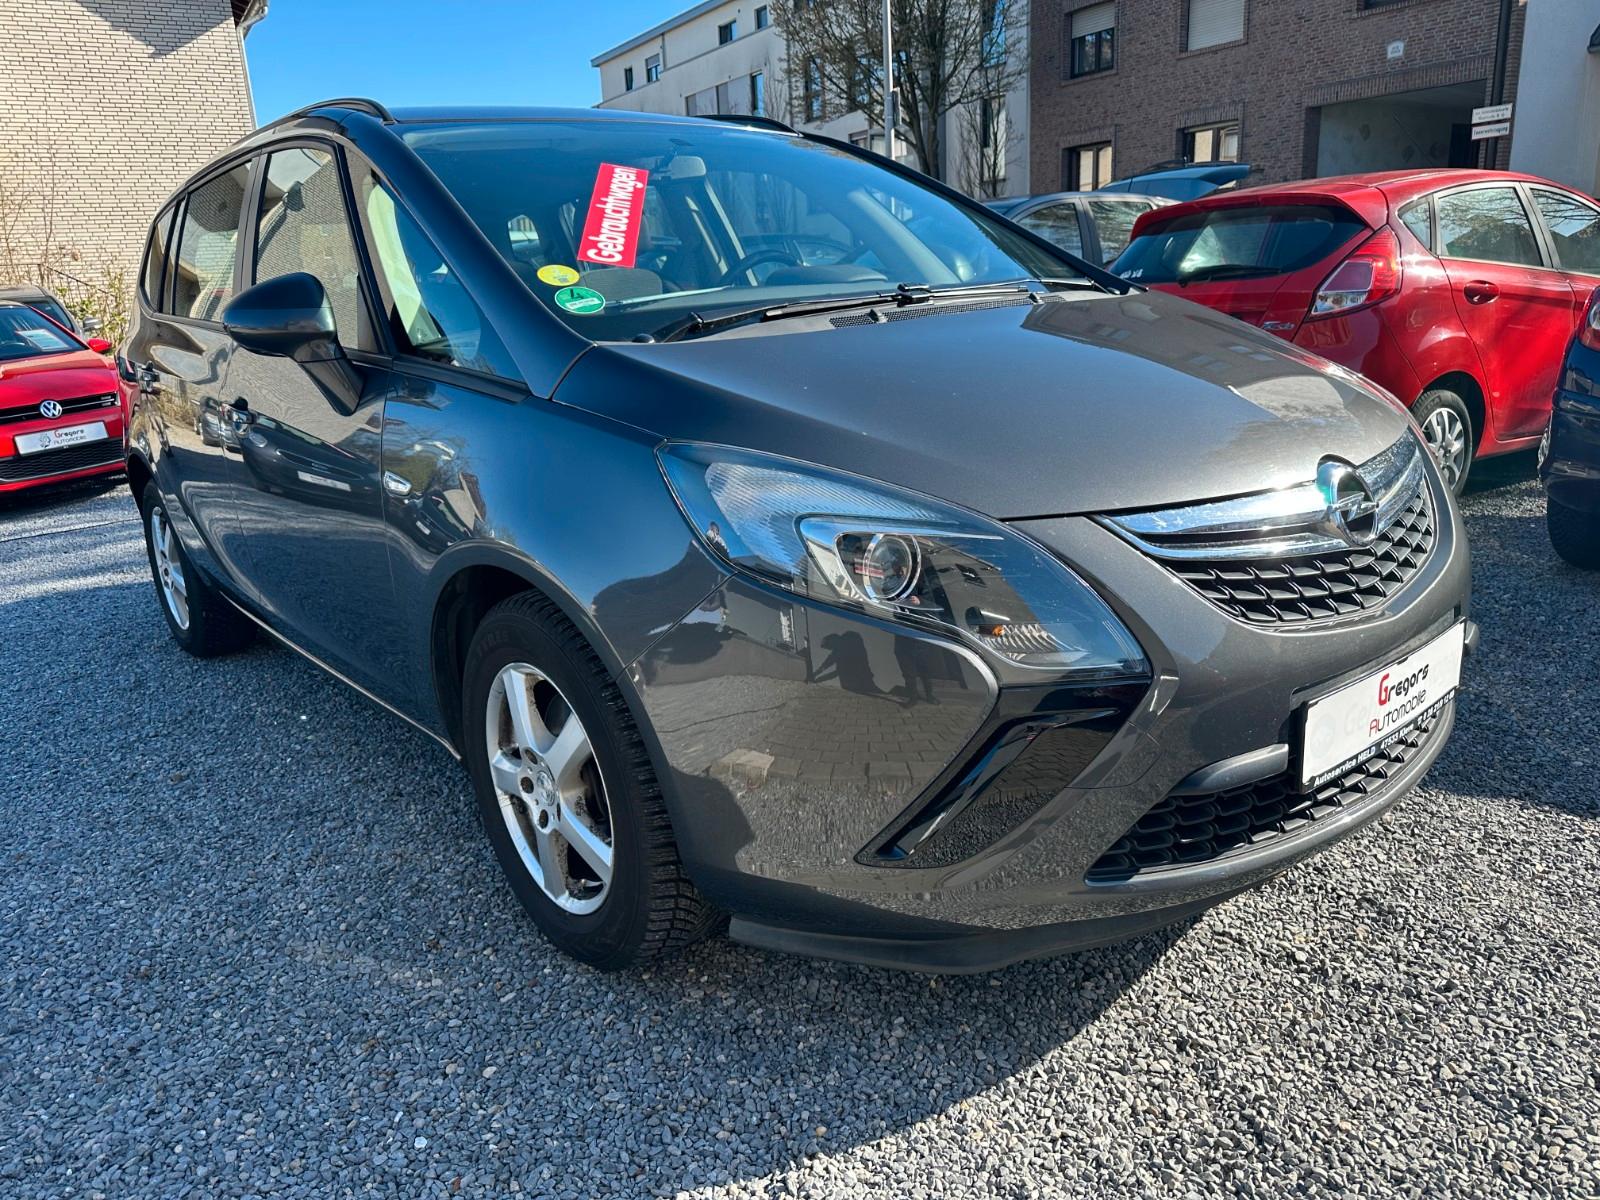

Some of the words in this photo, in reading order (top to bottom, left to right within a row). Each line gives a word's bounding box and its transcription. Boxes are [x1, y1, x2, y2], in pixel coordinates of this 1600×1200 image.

[586, 167, 644, 263] Gebrauchtwagen
[1378, 663, 1429, 706] Gregors
[1313, 759, 1357, 787] Autoservice
[1357, 746, 1376, 764] HELD
